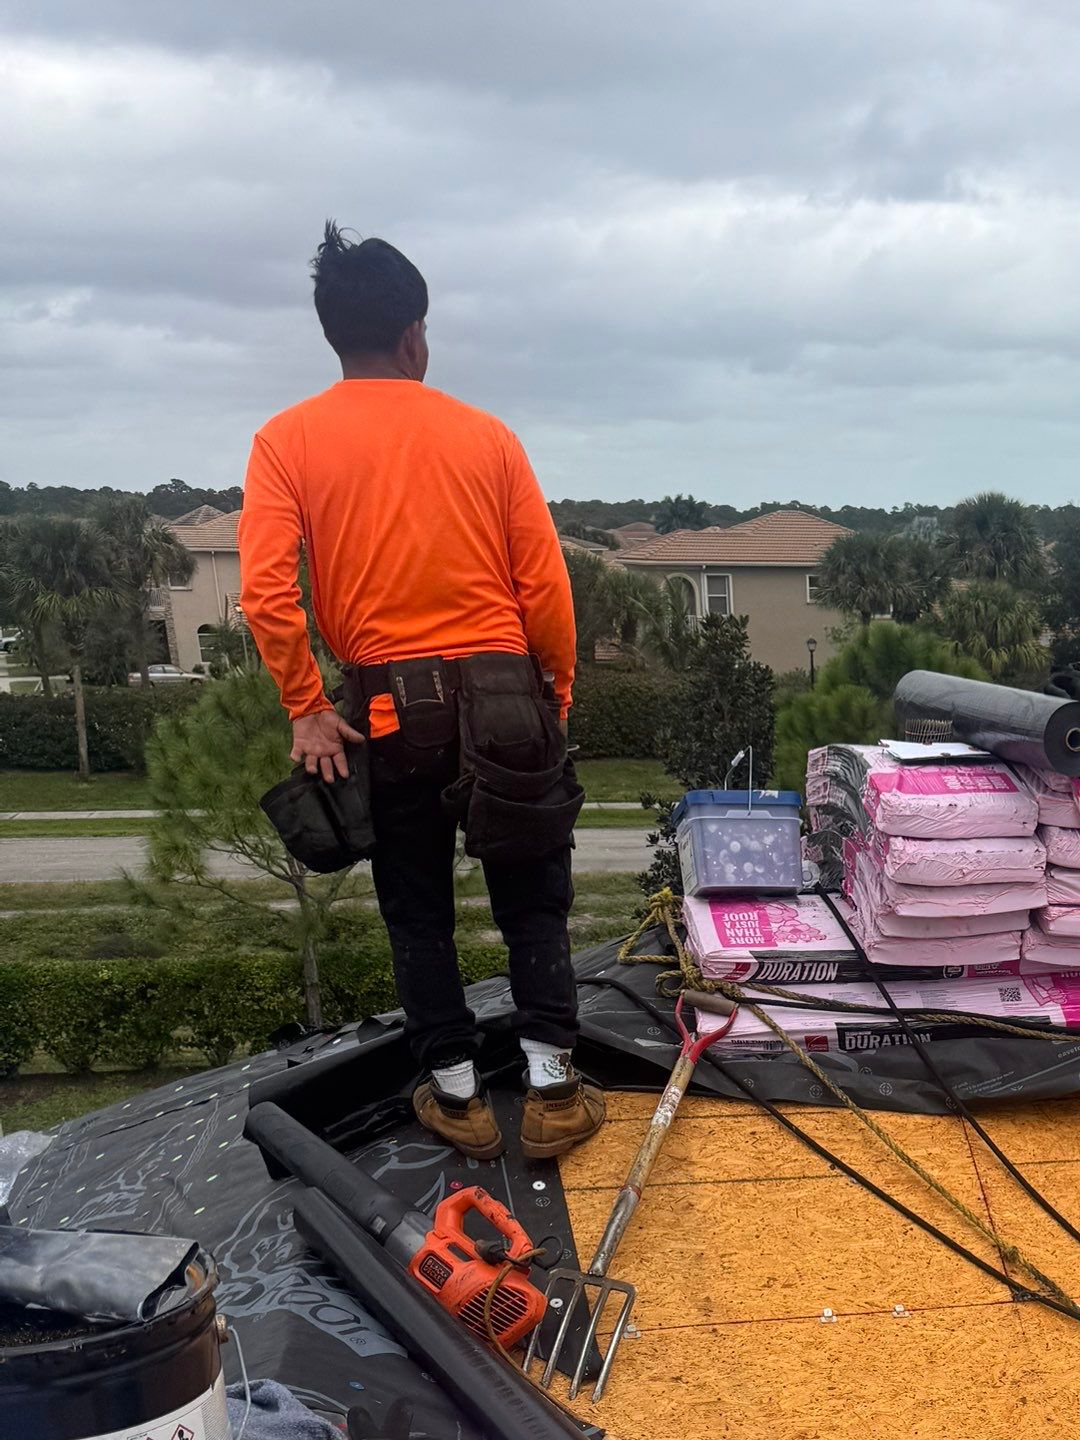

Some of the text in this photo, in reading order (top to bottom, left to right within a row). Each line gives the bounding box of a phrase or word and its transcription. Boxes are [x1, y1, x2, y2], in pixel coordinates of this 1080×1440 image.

[722, 912, 759, 921] ROOF
[723, 920, 760, 929] JUST A
[726, 928, 765, 937] THAN
[729, 936, 765, 944] MORE
[757, 962, 838, 981] DURATION
